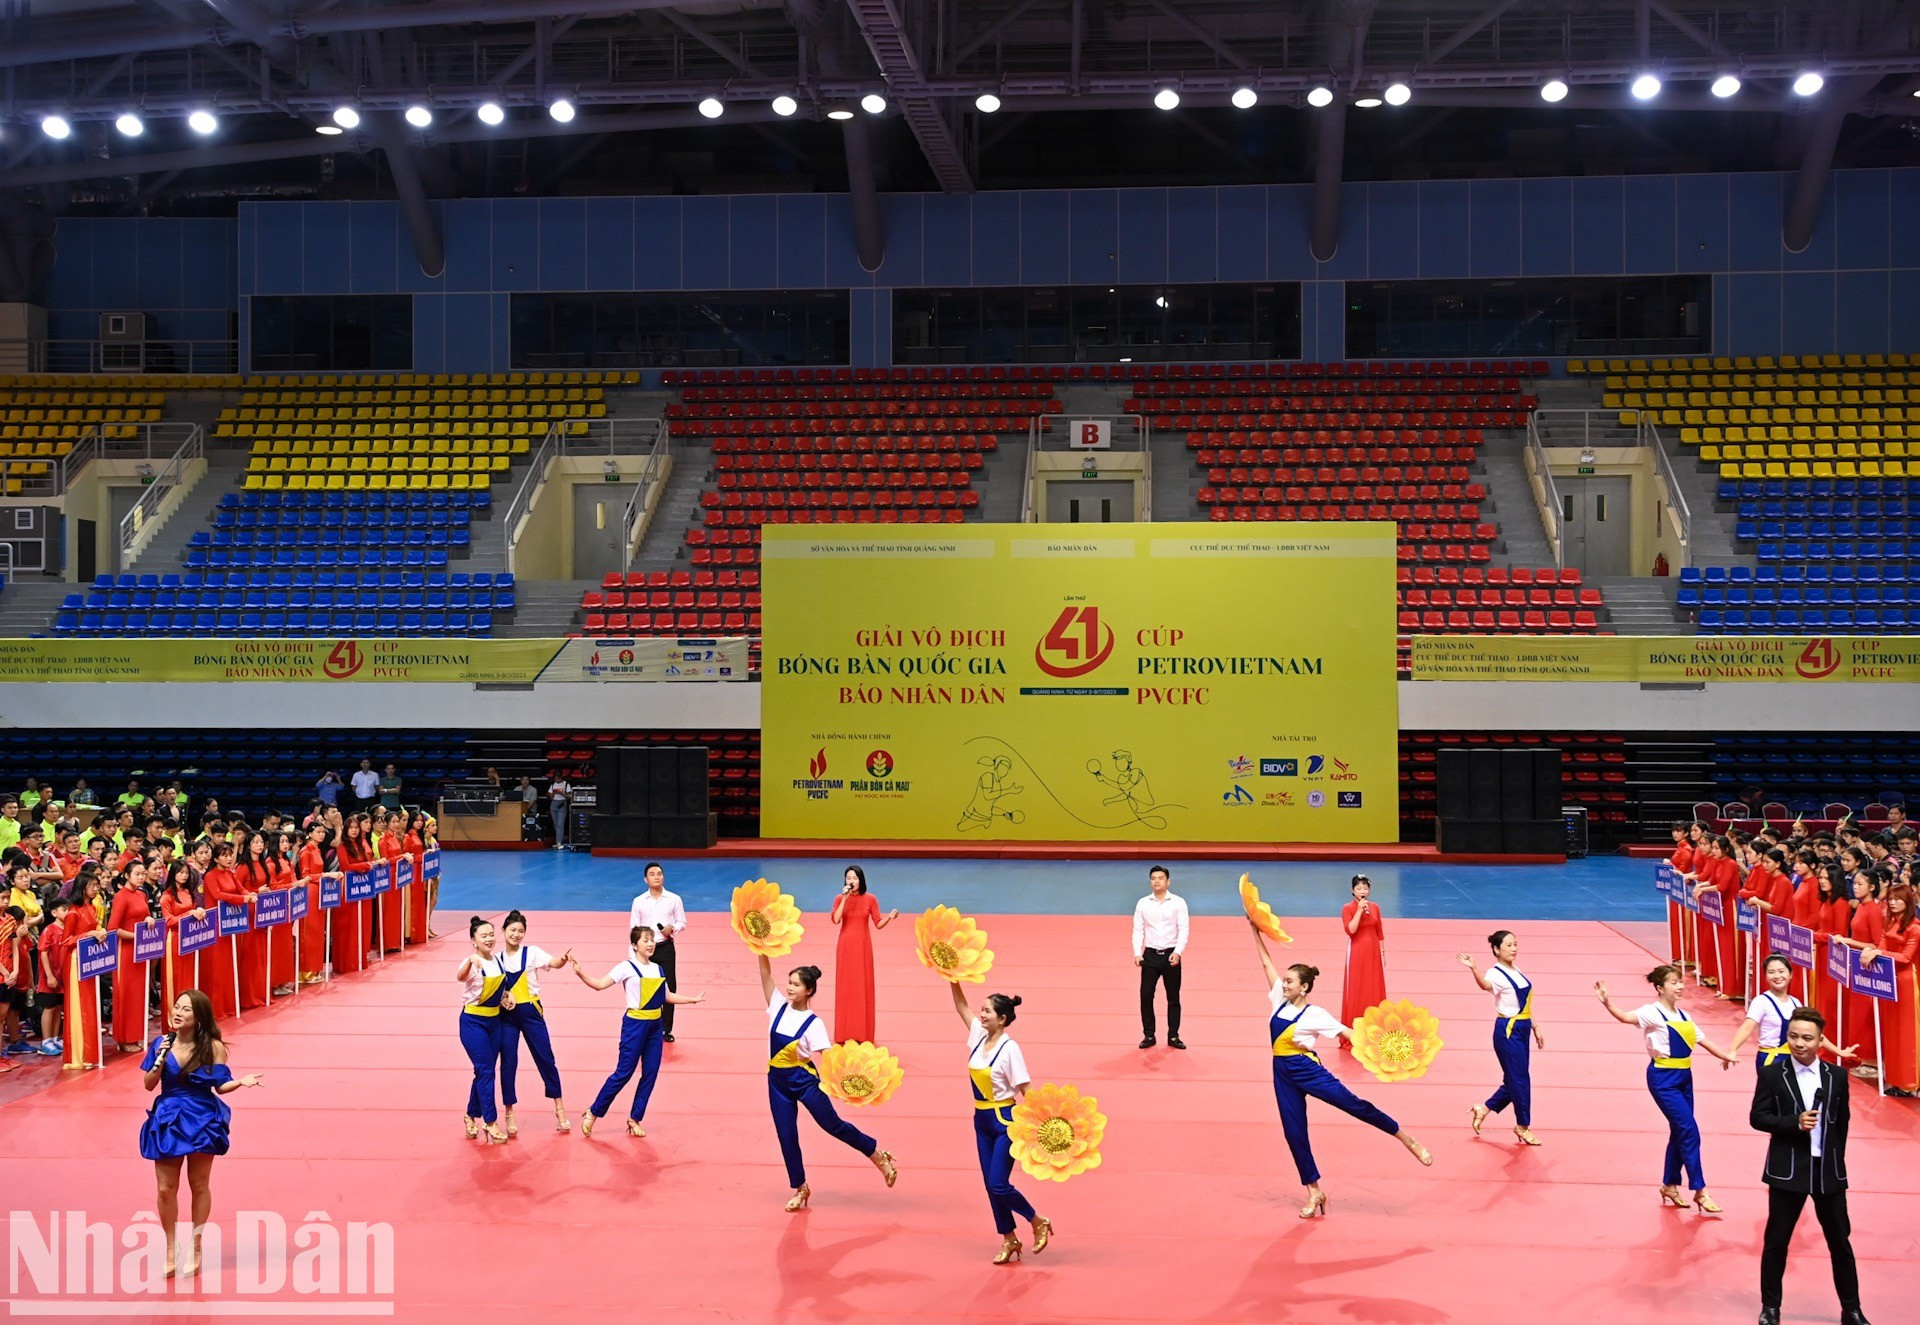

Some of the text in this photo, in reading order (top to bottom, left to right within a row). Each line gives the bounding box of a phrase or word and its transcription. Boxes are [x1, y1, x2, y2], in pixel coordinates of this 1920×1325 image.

[1082, 424, 1099, 444] B
[856, 624, 1006, 650] GIẢI VÔ ĐỊCH
[1045, 607, 1098, 659] 41
[1136, 625, 1184, 646] CÚP
[236, 640, 313, 654] GIẢI VÔ ĐỊCH
[374, 640, 398, 652] CÚP
[1696, 638, 1783, 652] GIẢI VÔ ĐỊCH
[1852, 638, 1879, 650] CÚP
[194, 653, 313, 666] BÓNG BÀN QUỐC GIA
[329, 641, 356, 668] 41
[374, 655, 469, 664] PETROVIETNAM
[1650, 651, 1784, 665] BÓNG BÀN QUỐC GIA
[1801, 639, 1831, 668] 41
[226, 666, 313, 677] BÁO NHÂN DÂN
[778, 652, 1007, 677] BÓNG BÀN QUỐC GIA
[1138, 657, 1322, 675] PETROVIETNAM
[1685, 666, 1784, 677] BÁO NHÂN DÂN
[374, 668, 412, 677] PVCFC
[1853, 667, 1895, 677] PVCFC
[840, 684, 1006, 704] BÁO NHÂN DÂN
[1137, 688, 1209, 705] PVCFC
[1263, 764, 1286, 772] BIDV
[793, 780, 843, 789] PETROVIETNAM
[850, 779, 909, 791] PHÂN BÓN CÀ MAU
[808, 790, 828, 799] PVCFC
[351, 884, 371, 895] HÀ NỘI
[1854, 974, 1892, 993] VĨNH LONG
